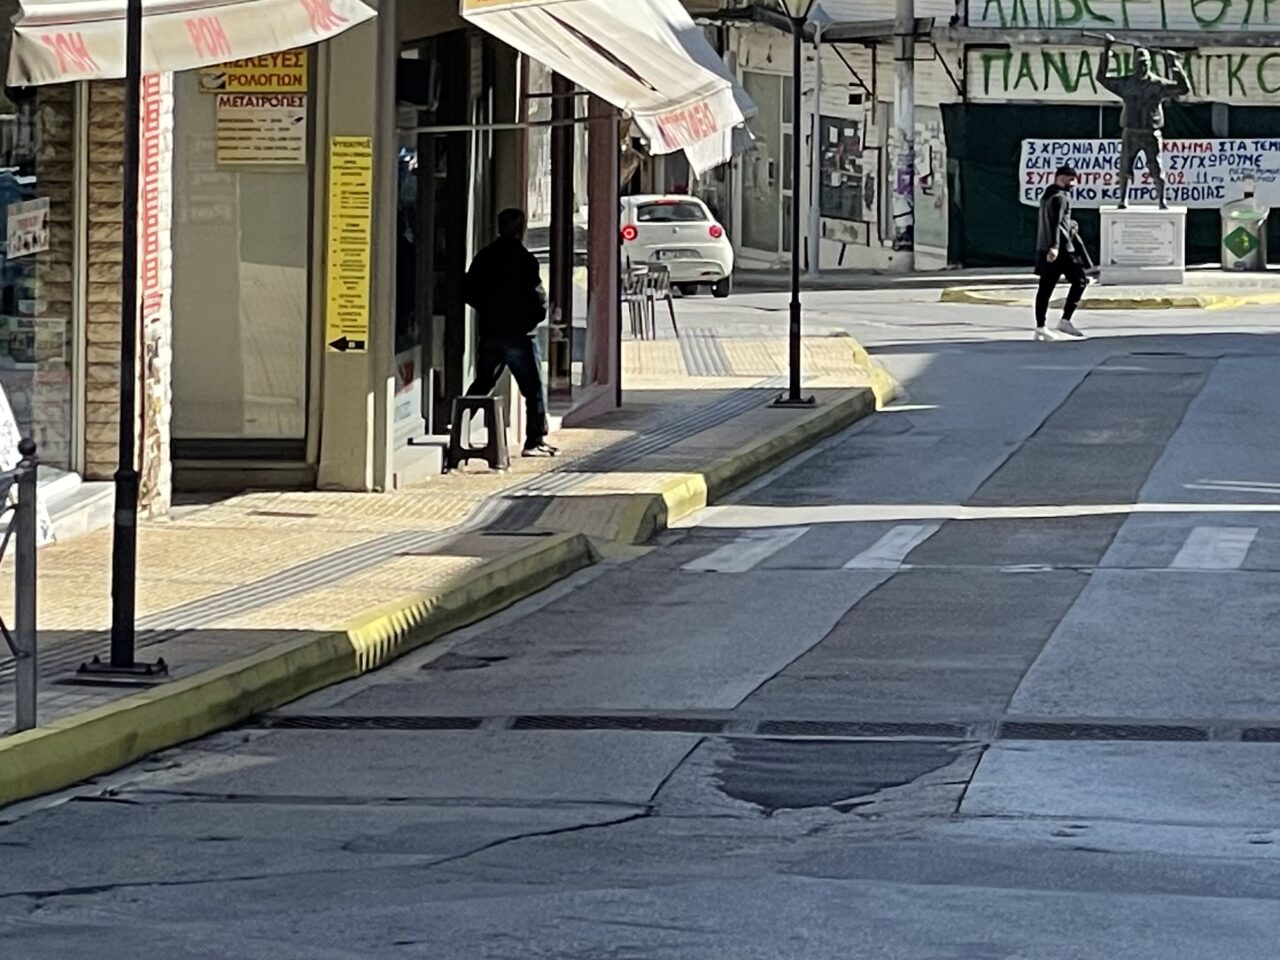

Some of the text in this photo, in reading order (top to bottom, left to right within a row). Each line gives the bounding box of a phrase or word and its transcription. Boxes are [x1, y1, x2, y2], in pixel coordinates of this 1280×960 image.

[186, 15, 233, 58] ΡΟΗ
[228, 73, 303, 88] ΡΟΛΟΓΙΩΝ
[219, 95, 304, 108] ΜΕΤΑΤΡΟΠΕΣ
[1027, 142, 1036, 156] 3
[1040, 142, 1093, 156] ΧΡΟΝΙΑ
[1218, 141, 1247, 152] ΣΤΑ
[1026, 156, 1051, 169] ΔΕΝ
[1169, 154, 1263, 170] ΣΥΓΧΩΡΟΥΜΕ
